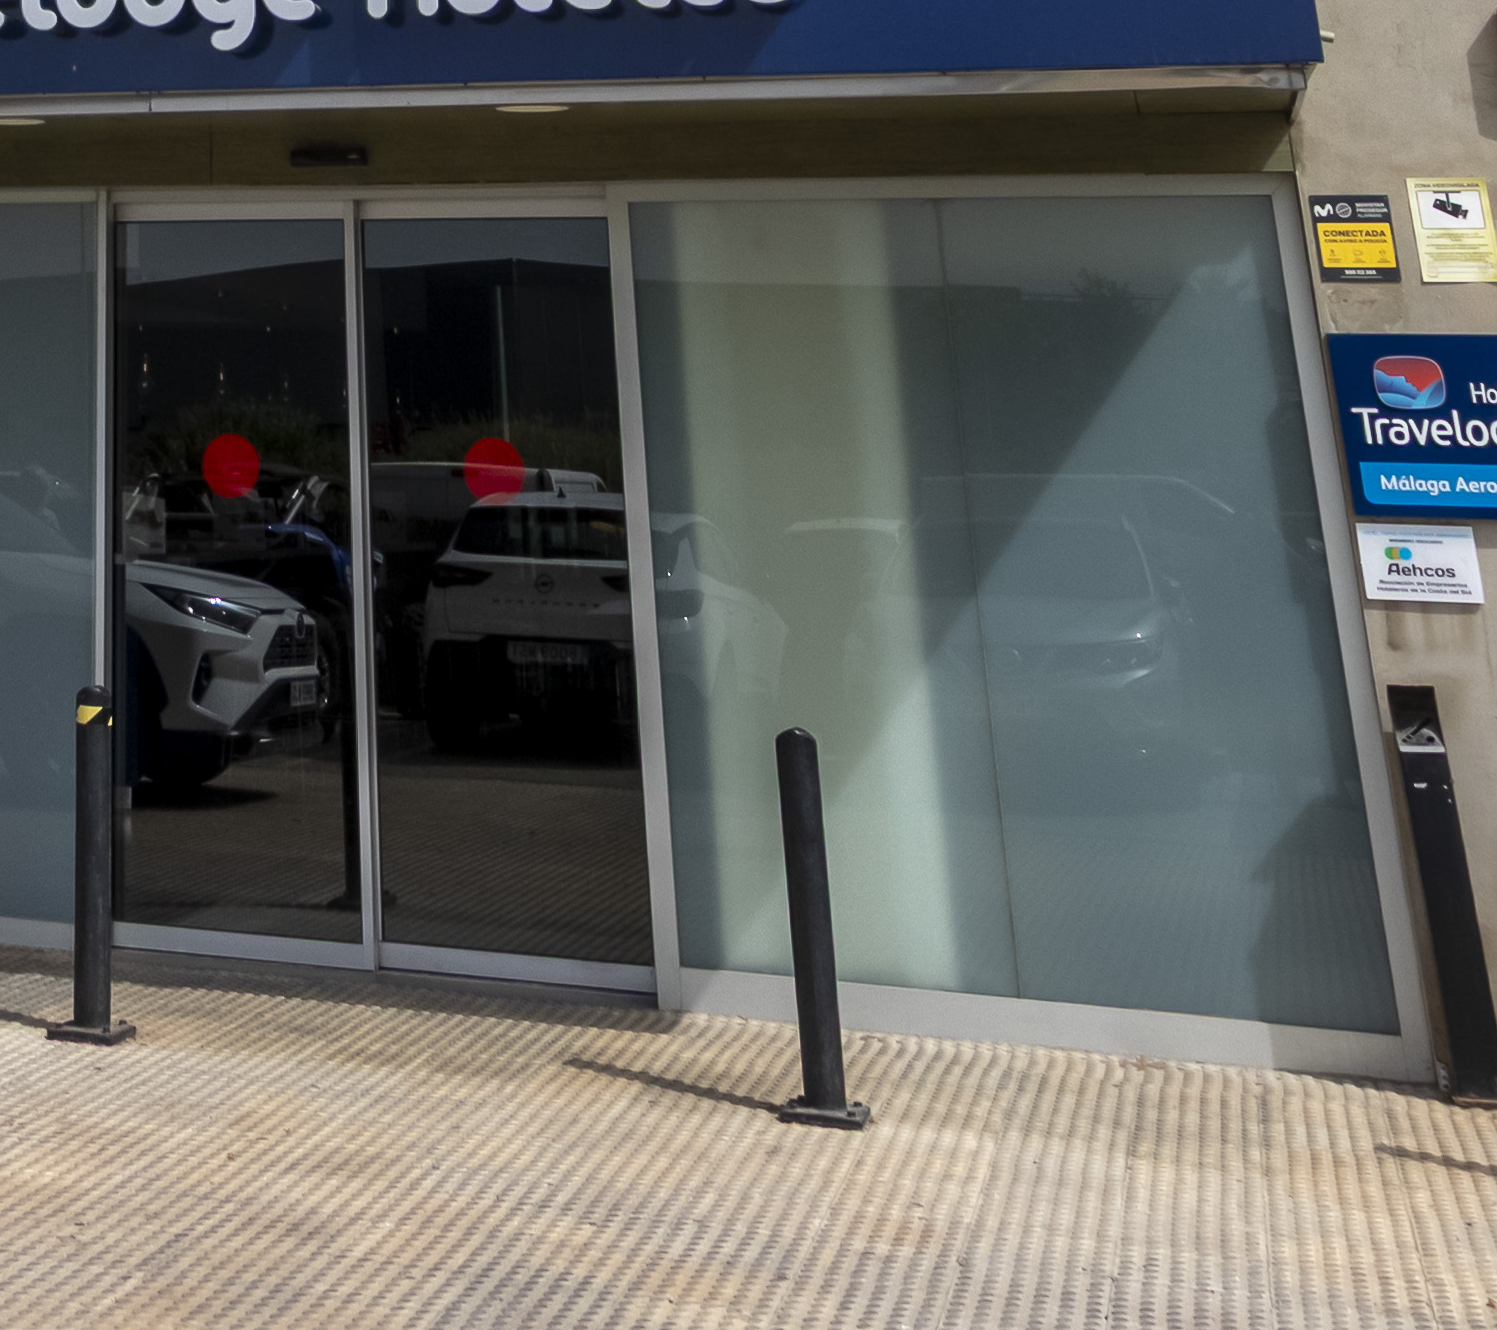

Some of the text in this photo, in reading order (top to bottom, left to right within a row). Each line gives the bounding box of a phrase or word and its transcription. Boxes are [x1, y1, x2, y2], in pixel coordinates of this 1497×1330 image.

[1323, 230, 1386, 238] CONECTADA
[1380, 474, 1450, 496] Málaga
[1387, 563, 1456, 578] Aehcos
